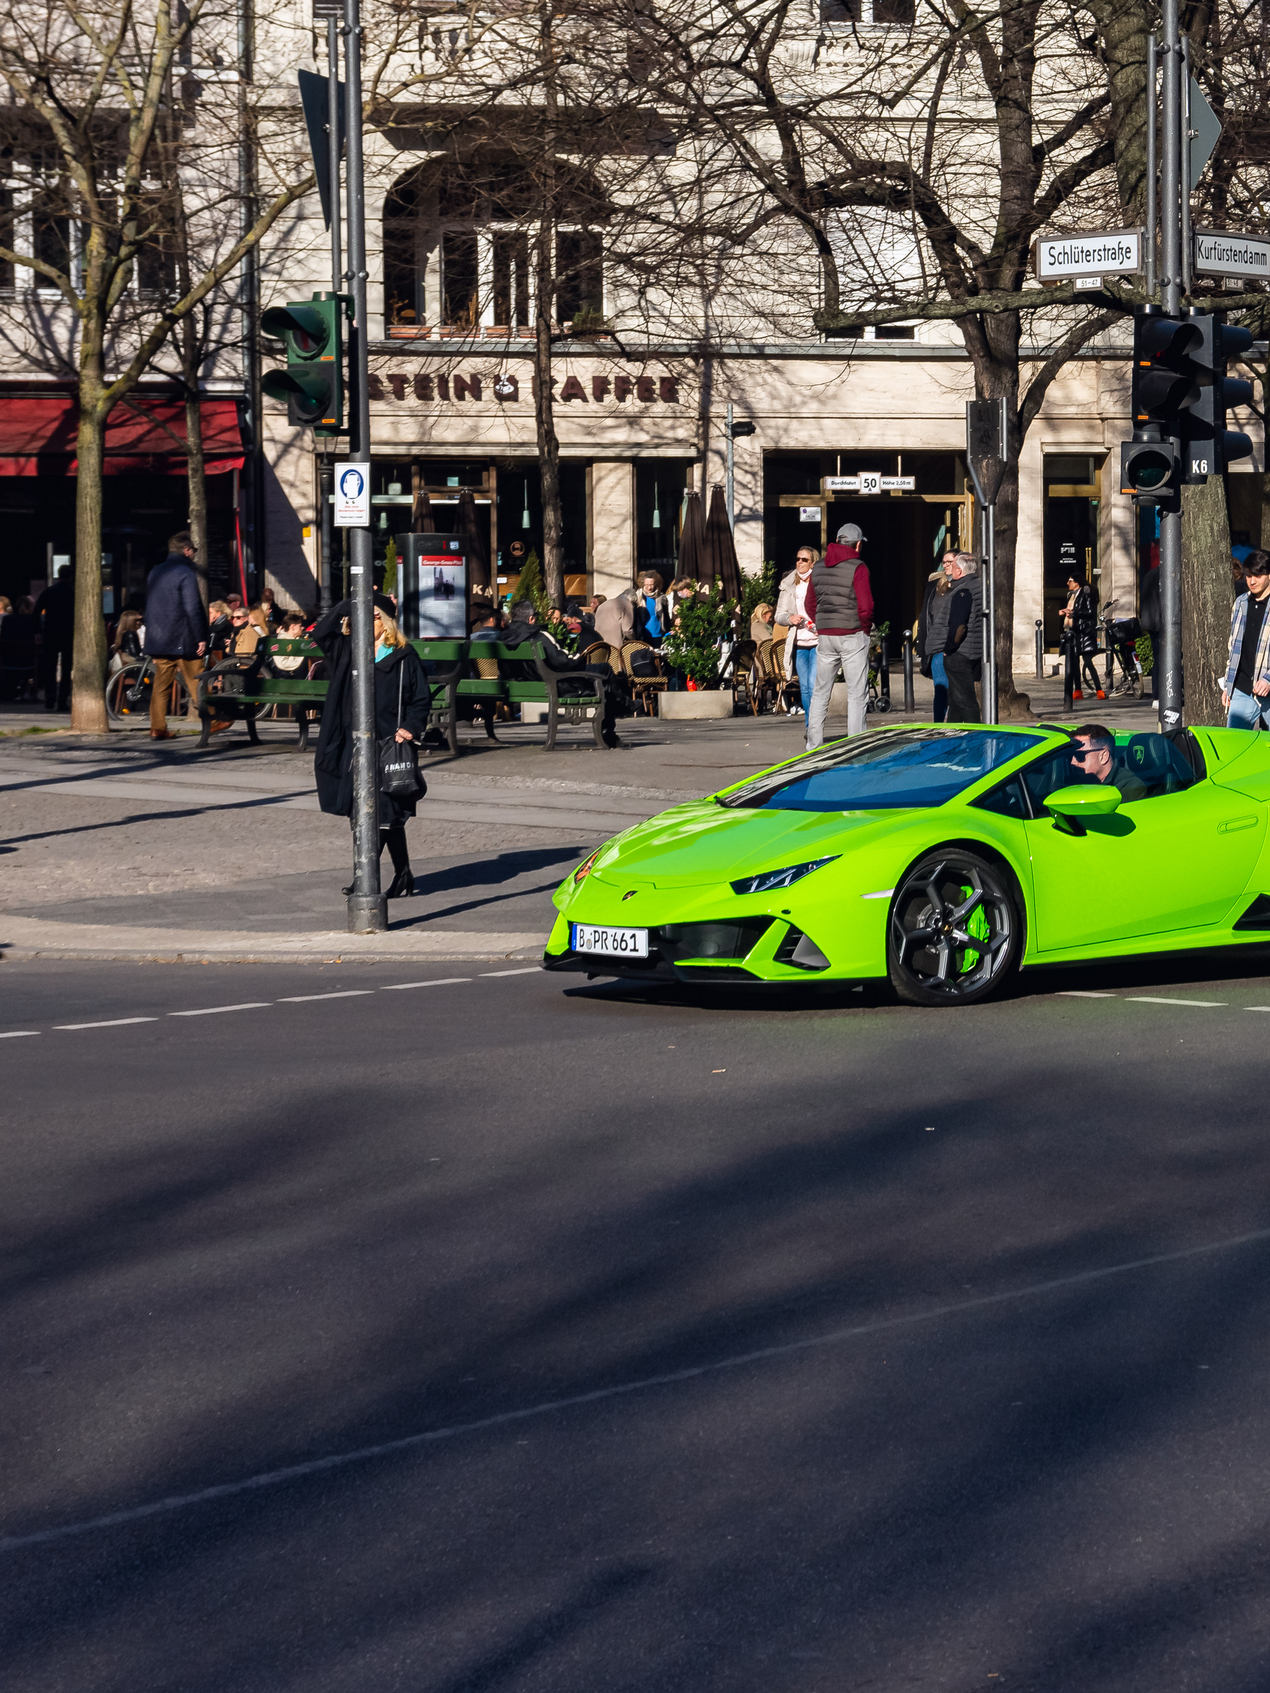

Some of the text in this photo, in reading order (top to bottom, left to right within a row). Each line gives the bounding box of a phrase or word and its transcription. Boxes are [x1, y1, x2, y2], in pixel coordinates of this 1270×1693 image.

[1048, 241, 1132, 266] Schlüterstraße
[1197, 236, 1268, 266] Kurfürstendamm
[1192, 459, 1208, 474] K6
[863, 478, 877, 488] 50
[579, 928, 639, 952] B PR 661
